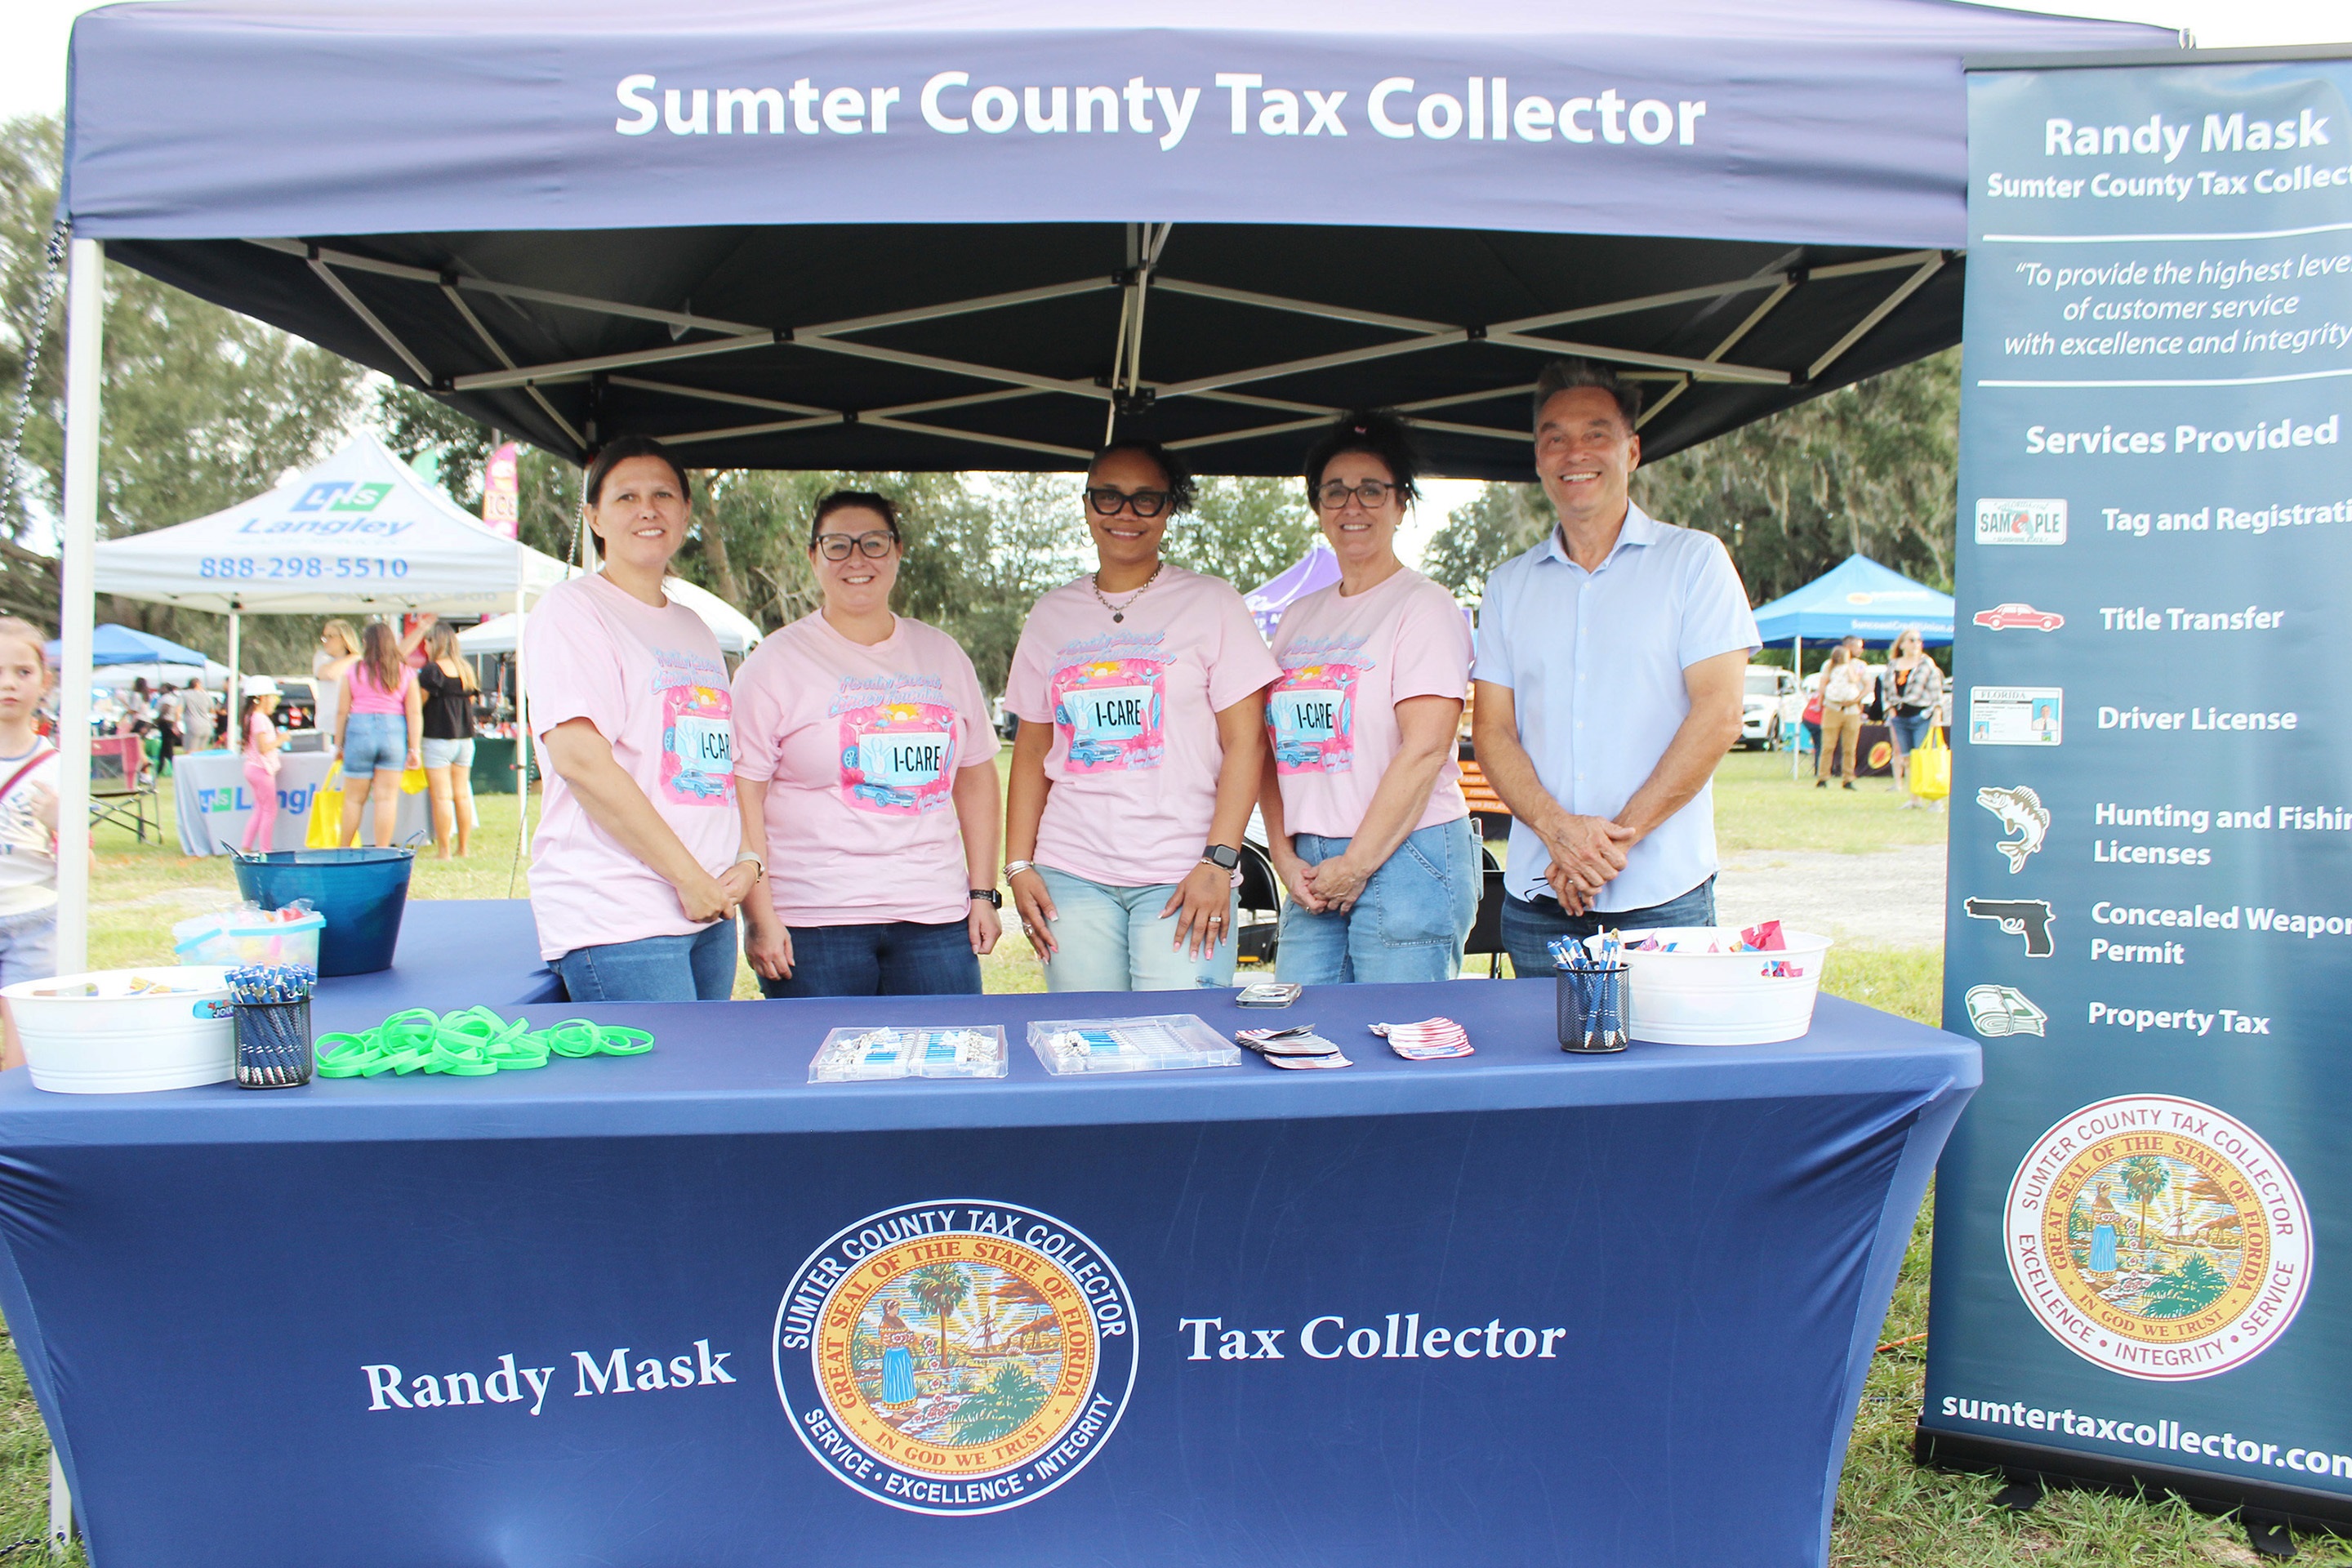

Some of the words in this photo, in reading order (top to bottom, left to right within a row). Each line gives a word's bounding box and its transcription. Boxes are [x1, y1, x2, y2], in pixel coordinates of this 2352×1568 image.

[616, 74, 900, 135] Sumter
[920, 71, 1200, 151] County
[1215, 73, 1348, 136] Tax
[1367, 77, 1706, 145] Collector
[2045, 114, 2192, 164] Randy
[2200, 108, 2331, 154] Mask
[1987, 172, 2085, 198] Sumter
[2091, 172, 2194, 203] County
[2197, 170, 2247, 197] Tax
[2055, 261, 2148, 292] provide
[2153, 259, 2192, 285] the
[2197, 256, 2292, 289] highest
[2296, 253, 2352, 278] leve
[2062, 296, 2092, 322] of
[2092, 299, 2207, 321] customer
[2211, 294, 2299, 319] service
[2005, 332, 2055, 356] with
[2060, 331, 2184, 355] excellence
[2188, 329, 2237, 354] and
[2243, 322, 2352, 354] integrity
[2025, 425, 2167, 454] Services
[2174, 414, 2340, 453] Provided
[238, 517, 415, 537] Langley
[2101, 508, 2150, 537] Tag
[2156, 506, 2210, 532] and
[2216, 498, 2352, 535] Registrati
[200, 557, 408, 578] 888-298-5510
[2099, 607, 2162, 630] Title
[2166, 605, 2285, 630] Transfer
[1981, 691, 2026, 699] FLORIDA
[1096, 700, 1141, 727] I-CARE
[1296, 703, 1334, 728] I-CARE
[2097, 706, 2185, 730] Driver
[2191, 707, 2297, 730] License
[701, 733, 731, 760] I-CAR
[893, 746, 941, 772] I-CARE
[2095, 802, 2210, 834] Hunting
[2216, 805, 2272, 829] and
[2094, 840, 2212, 866] Licenses
[2091, 901, 2239, 929] Concealed
[2090, 938, 2185, 964] Permit
[213, 1006, 234, 1018] JOLL
[2088, 1002, 2215, 1036] Property
[2218, 1009, 2270, 1034] Tax
[2091, 1144, 2117, 1163] OF
[2121, 1135, 2164, 1152] THE
[2172, 1138, 2227, 1178] STATE
[2022, 1136, 2077, 1211] SUMTER
[2078, 1108, 2163, 1143] COUNTY
[2171, 1111, 2209, 1138] TAX
[2213, 1129, 2294, 1236] COLLECTOR
[2054, 1160, 2092, 1201] SEAL
[2229, 1179, 2252, 1205] OF
[907, 1241, 962, 1263] THE
[2048, 1208, 2069, 1270] GREAT
[2235, 1209, 2267, 1292] FLORIDA
[871, 1254, 904, 1280] OF
[973, 1243, 1042, 1278] STATE
[782, 1255, 848, 1351] SUMTER
[841, 1209, 956, 1261] COUNTY
[967, 1209, 1022, 1238] TAX
[1024, 1223, 1127, 1339] COLLECTOR
[1043, 1276, 1069, 1302] OF
[831, 1280, 874, 1330] SEAL
[2019, 1234, 2096, 1344] EXCELLENCE
[2114, 1338, 2226, 1366] INTEGRITY
[2241, 1260, 2296, 1337] SERVICE
[2078, 1294, 2097, 1312] IN
[2101, 1309, 2136, 1333] GOD
[2143, 1324, 2170, 1337] WE
[2174, 1308, 2225, 1336] TRUST
[1057, 1306, 1087, 1398] FLORIDA
[1178, 1316, 1285, 1361] Tax
[1299, 1312, 1566, 1361] Collector
[361, 1352, 556, 1416] Randy
[571, 1338, 737, 1396] Mask
[826, 1337, 858, 1410] GREAT
[803, 1407, 875, 1480] SERVICE
[884, 1472, 1025, 1503] EXCELLENCE
[1035, 1392, 1114, 1481] INTEGRITY
[875, 1431, 898, 1451] IN
[904, 1446, 946, 1467] GOD
[954, 1453, 987, 1467] WE
[991, 1423, 1048, 1462] TRUST
